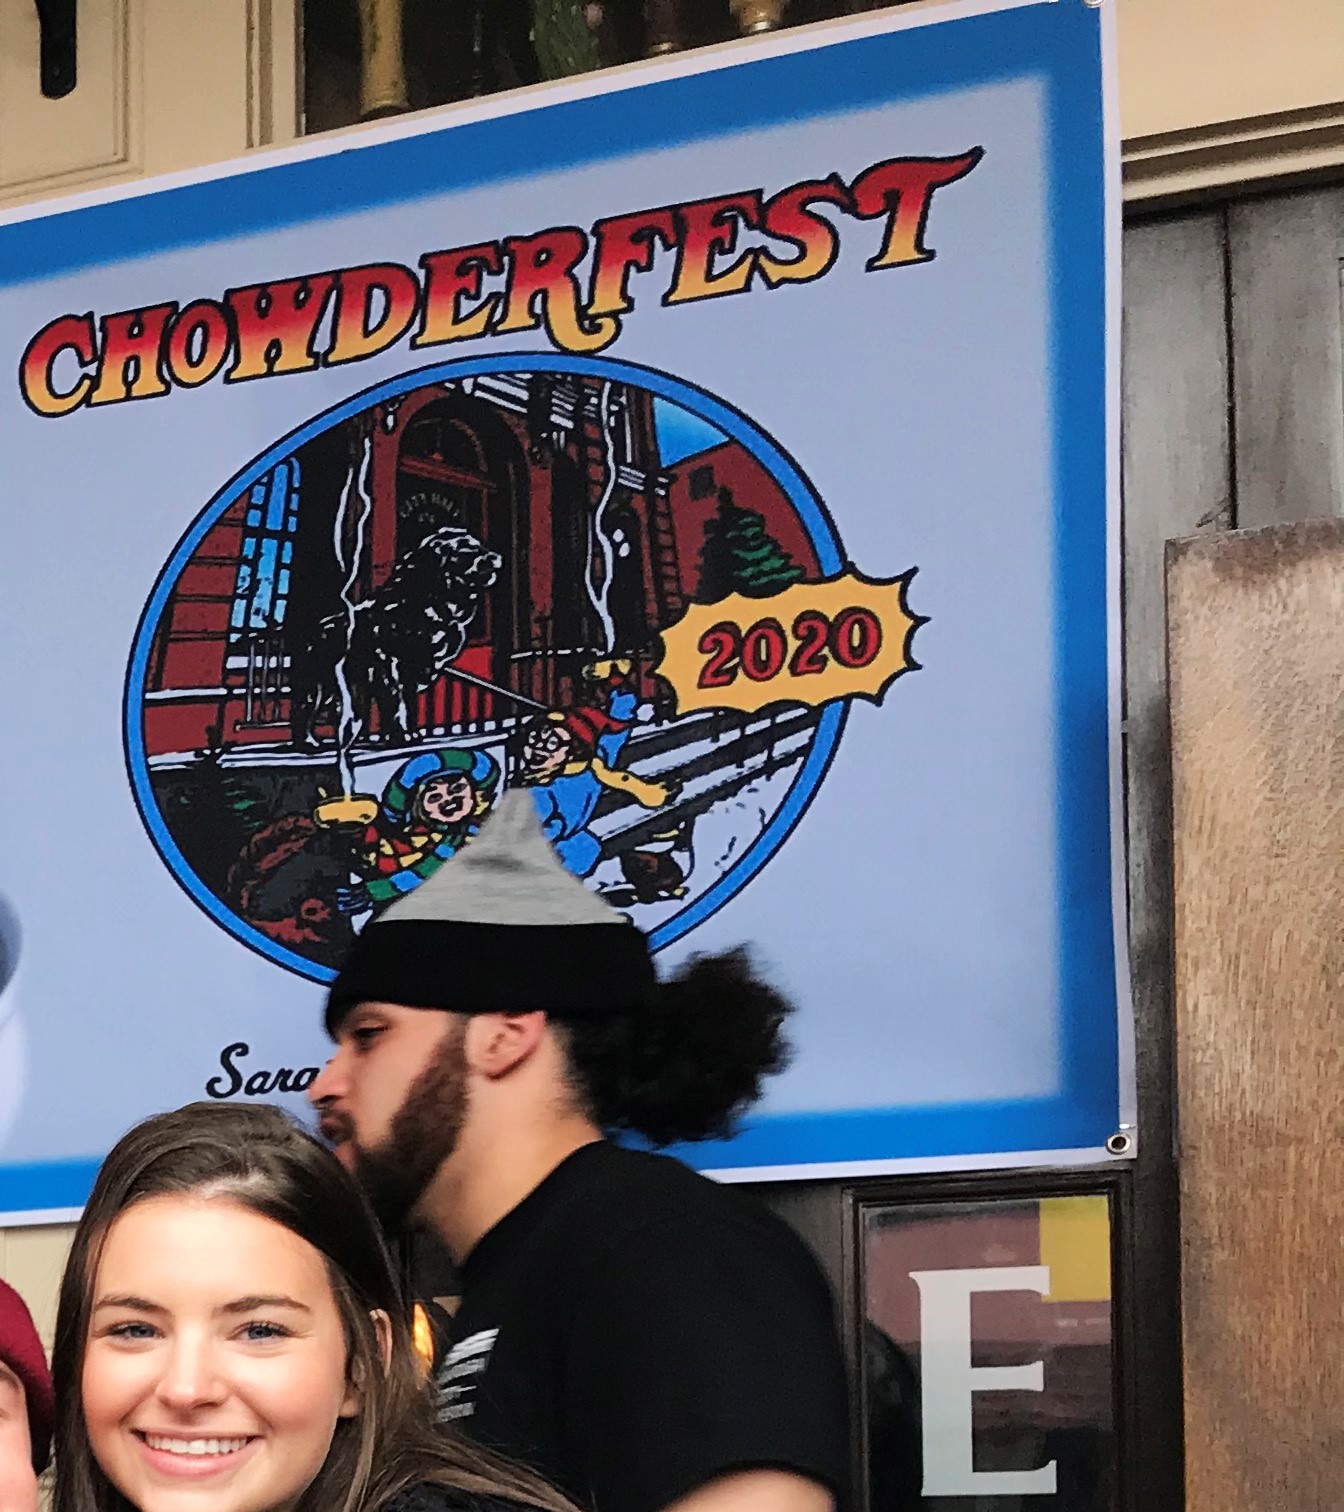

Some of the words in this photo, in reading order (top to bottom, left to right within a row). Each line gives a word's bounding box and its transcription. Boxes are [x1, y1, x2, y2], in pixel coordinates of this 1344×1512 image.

[19, 146, 984, 418] CHOWDERFEST
[696, 607, 881, 688] 2020
[206, 1042, 320, 1098] Sara
[909, 1264, 1059, 1497] E
